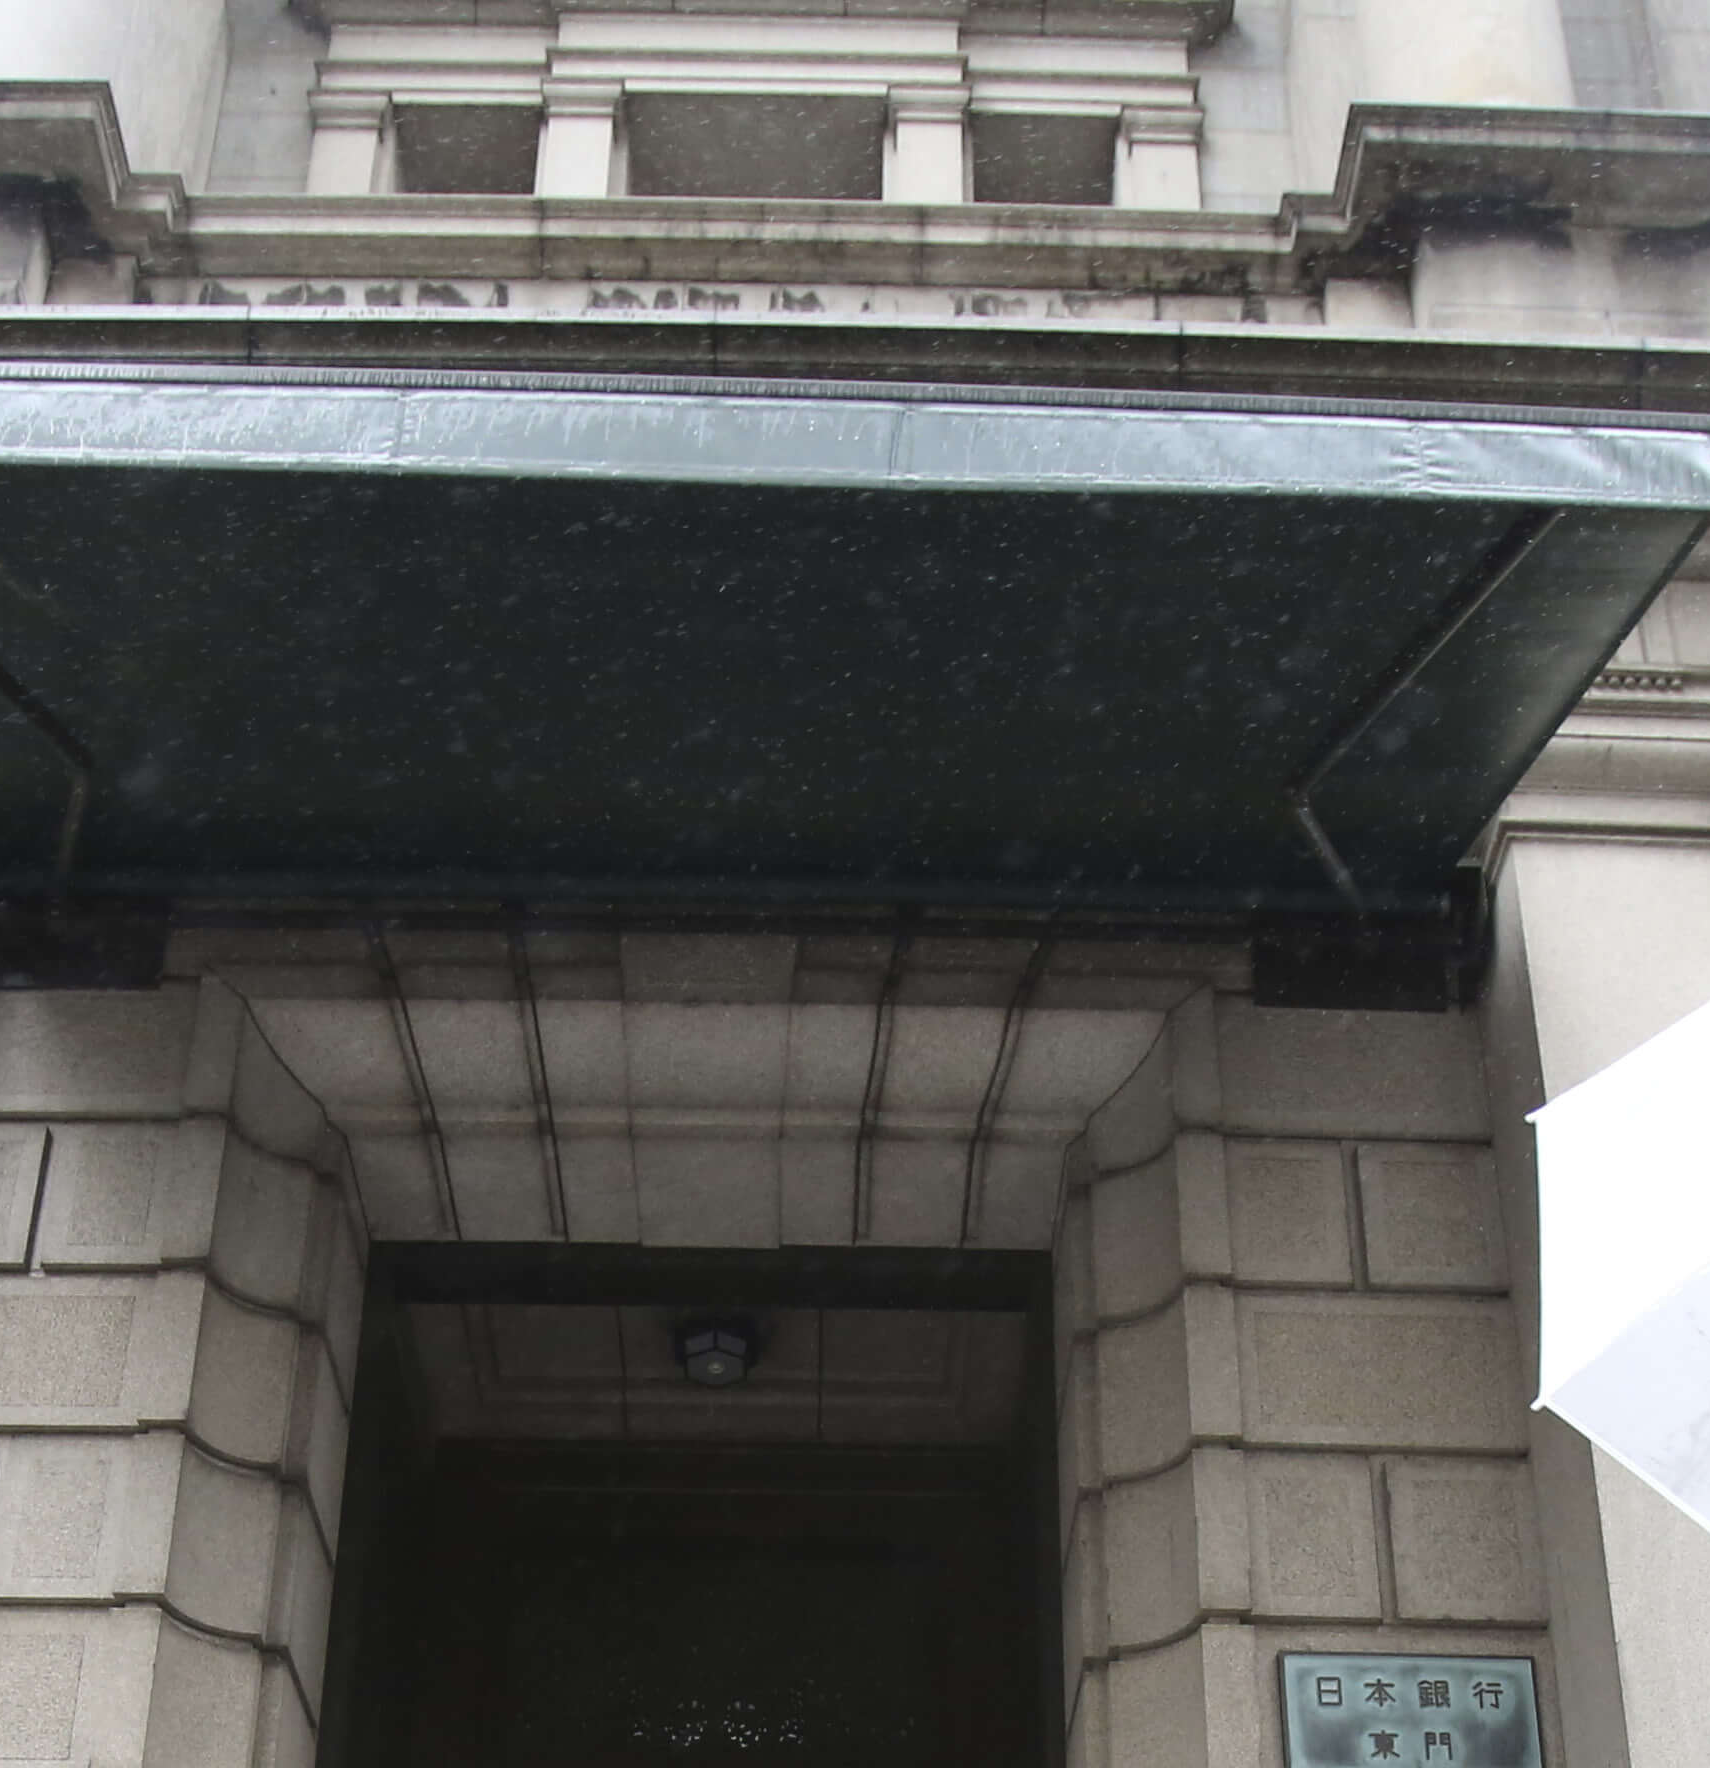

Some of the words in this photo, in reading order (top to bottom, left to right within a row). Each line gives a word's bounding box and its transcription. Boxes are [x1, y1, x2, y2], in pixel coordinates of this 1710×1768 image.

[1316, 1676, 1503, 1710] 日本銀行
[1368, 1730, 1453, 1761] 東門
